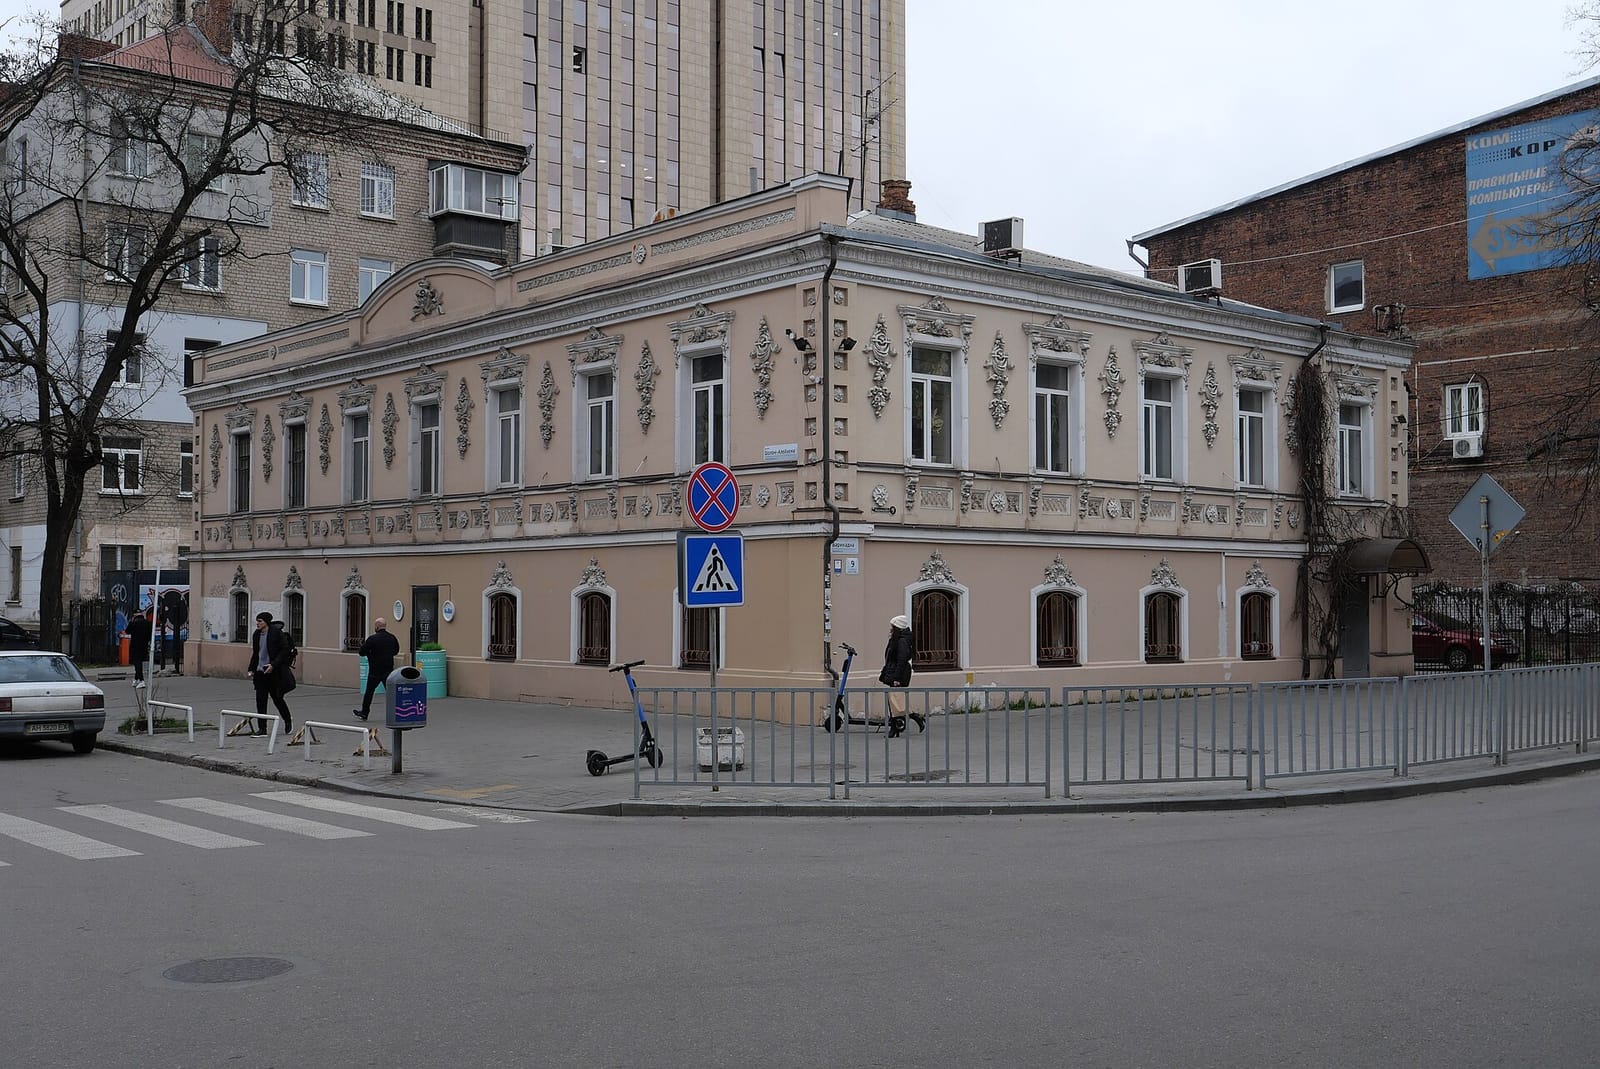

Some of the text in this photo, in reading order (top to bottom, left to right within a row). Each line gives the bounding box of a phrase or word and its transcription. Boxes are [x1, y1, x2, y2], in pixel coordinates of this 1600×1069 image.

[1469, 166, 1549, 191] ПРАВИЛЬНЫЕ
[1469, 181, 1553, 206] КОМПЬЮТЕРЫ
[850, 560, 855, 568] 9
